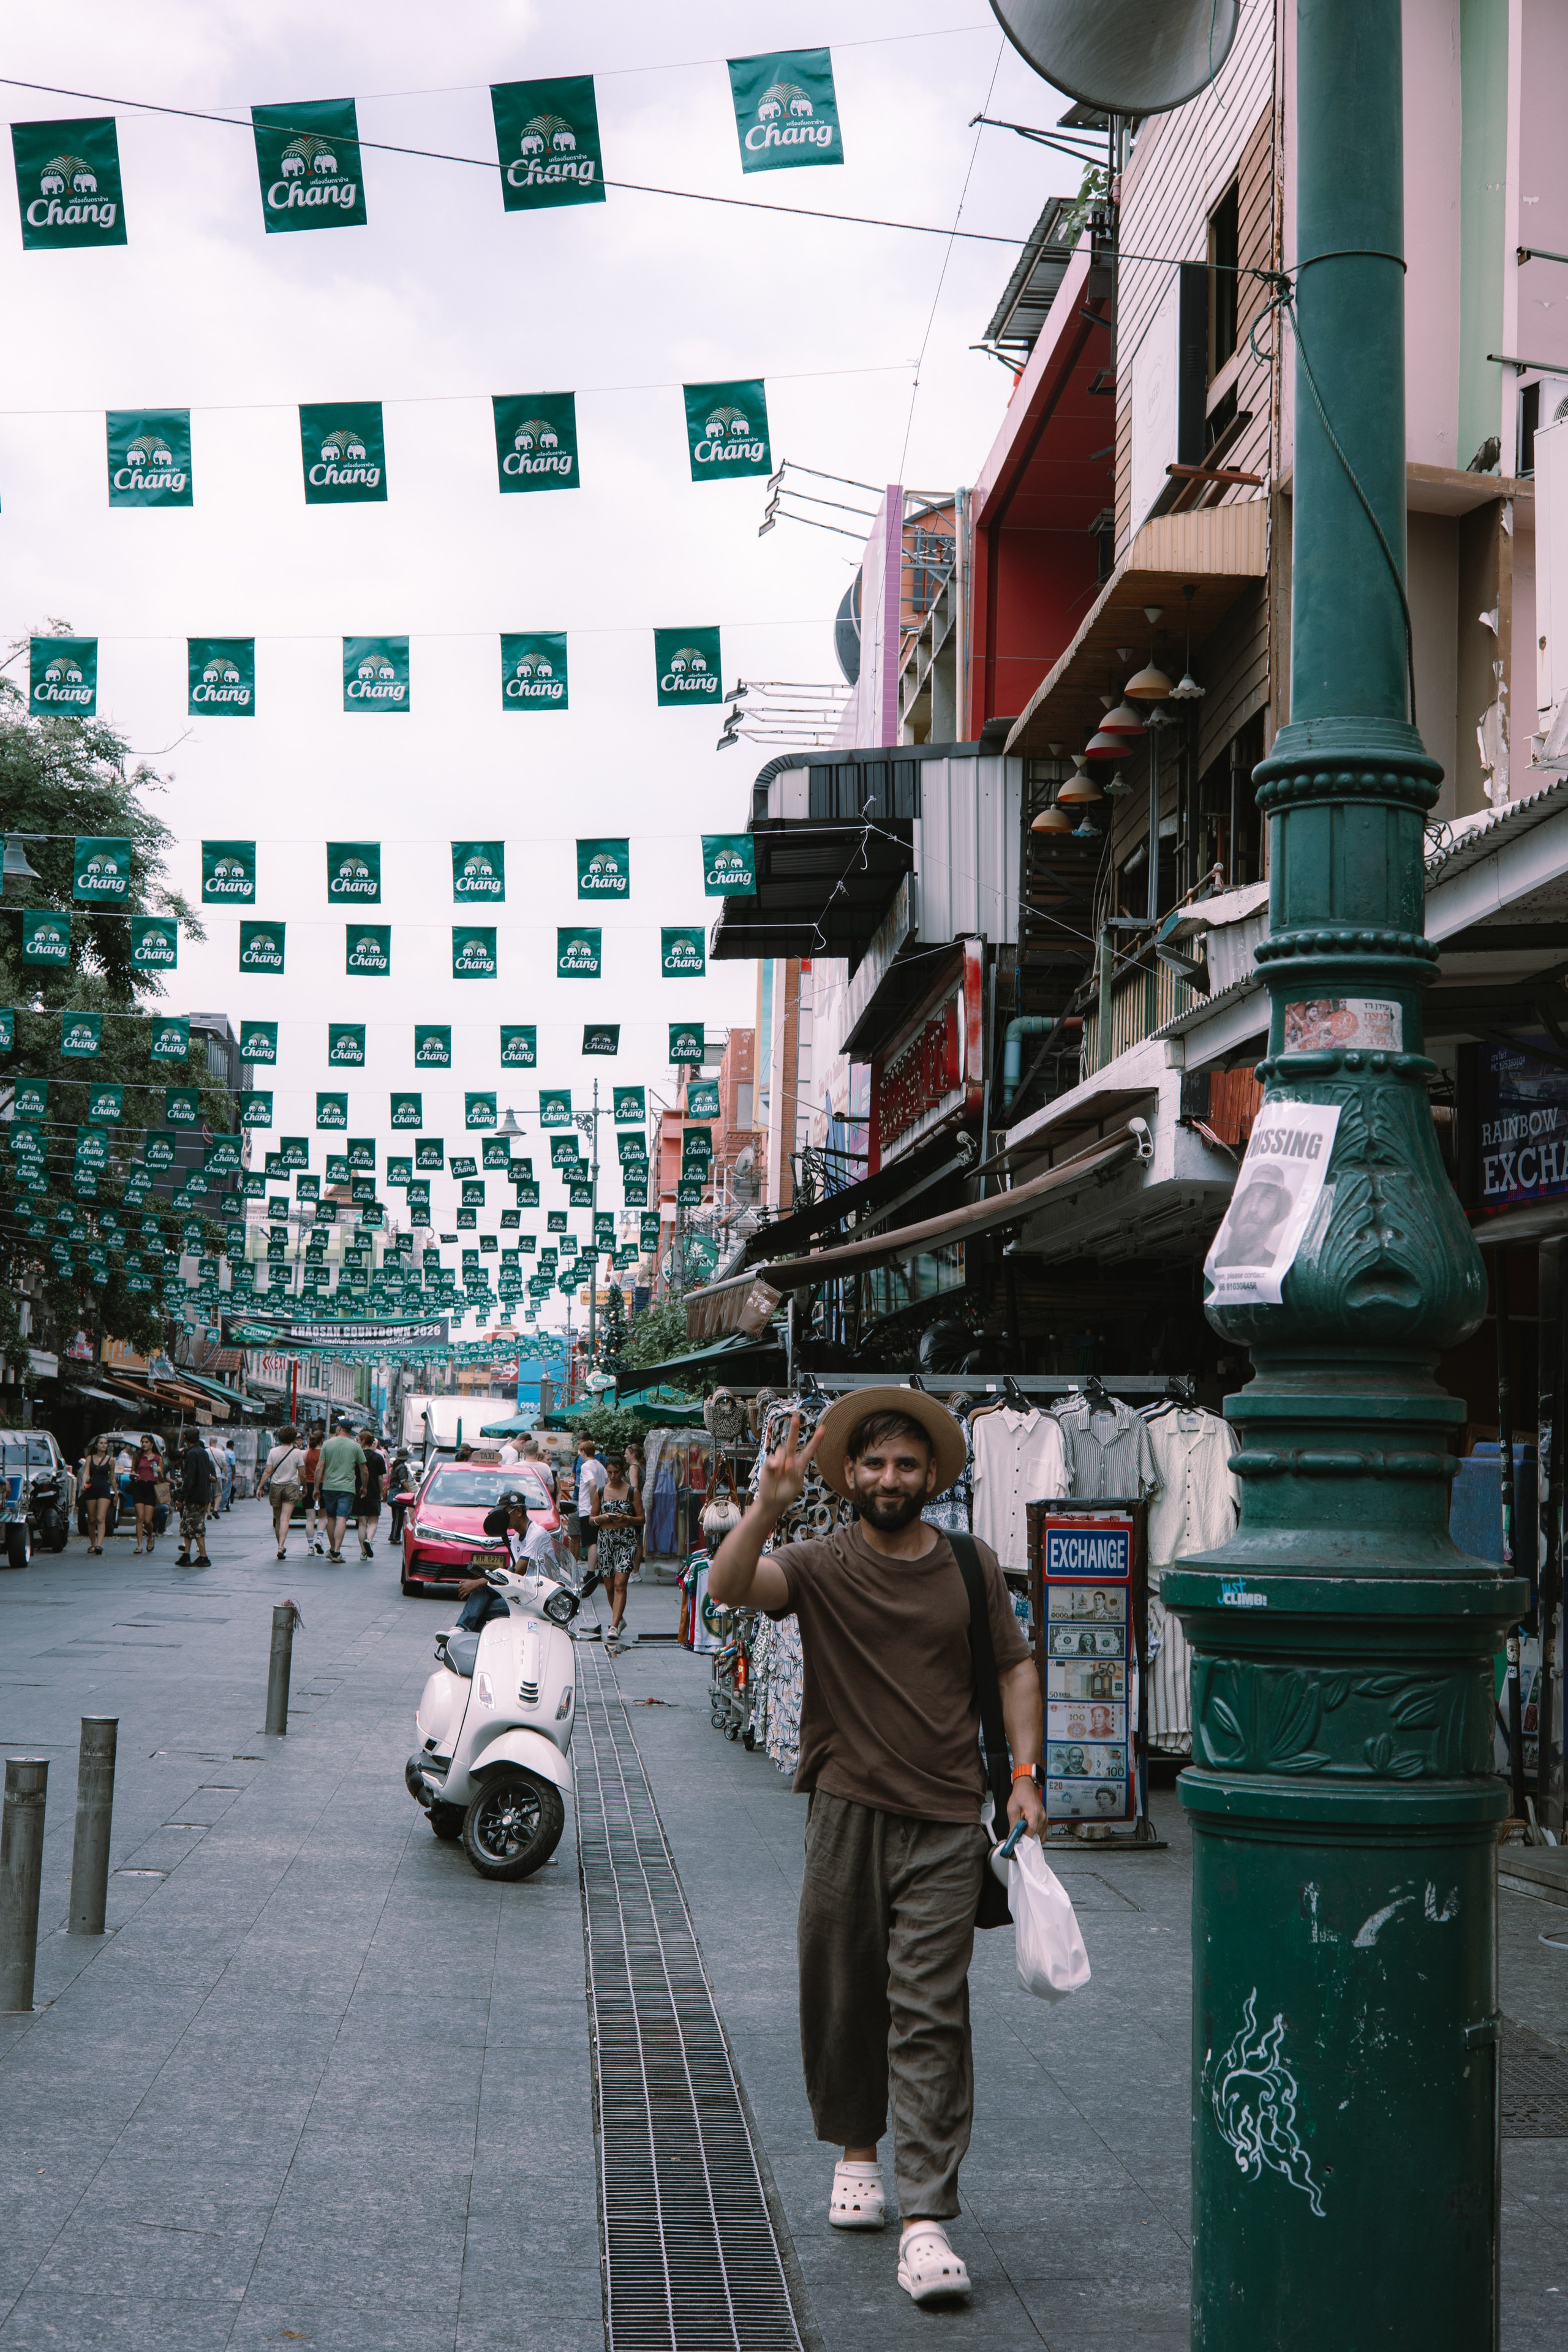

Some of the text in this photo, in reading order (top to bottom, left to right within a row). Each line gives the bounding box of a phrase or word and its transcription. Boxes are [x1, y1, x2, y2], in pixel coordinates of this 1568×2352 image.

[745, 122, 834, 151] Chang
[507, 158, 596, 187] Chang
[309, 176, 349, 185] เครื่องดื่มตราช้าง
[69, 195, 108, 205] เครื่องดื่มตราช้าง
[268, 181, 356, 209] Chang
[28, 198, 116, 228] Chang
[695, 441, 764, 463] Chang
[503, 453, 572, 475] Chang
[115, 469, 186, 492] Chang
[310, 464, 380, 487] Chang
[662, 674, 718, 692] Chang
[34, 684, 93, 704] Chang
[193, 684, 250, 705] Chang
[347, 680, 405, 701] Chang
[506, 680, 564, 699] Chang
[78, 875, 126, 892] Chang
[581, 875, 626, 891] Chang
[707, 871, 752, 886] Chang
[205, 878, 253, 895] Chang
[331, 879, 377, 895] Chang
[456, 878, 501, 893] Chang
[26, 942, 67, 957] Chang
[135, 948, 175, 962] Chang
[243, 951, 282, 966] Chang
[349, 954, 387, 968] Chang
[560, 957, 598, 971] Chang
[665, 957, 703, 970] Chang
[456, 958, 494, 971] Chang
[64, 1038, 97, 1051] Chang
[154, 1042, 186, 1055] Chang
[585, 1041, 616, 1052] Chang
[241, 1047, 274, 1059] Chang
[331, 1049, 363, 1061] Chang
[417, 1051, 450, 1063] Chang
[502, 1051, 533, 1063] Chang
[671, 1047, 702, 1058] Chang
[1491, 1063, 1499, 1072] MC
[16, 1101, 44, 1112] Chang
[92, 1106, 120, 1117] Chang
[690, 1103, 718, 1113] Chang
[167, 1109, 195, 1121] Chang
[244, 1112, 271, 1123] Chang
[541, 1112, 570, 1122] Chang
[616, 1109, 644, 1118] Chang
[317, 1115, 345, 1125] Chang
[393, 1115, 421, 1125] Chang
[467, 1115, 496, 1125] Chang
[1482, 1107, 1558, 1147] RAINBOW
[11, 1141, 37, 1151] Chang
[78, 1146, 104, 1156] Chang
[685, 1145, 711, 1155] Chang
[148, 1150, 173, 1159] Chang
[214, 1154, 239, 1163] Chang
[620, 1152, 645, 1160] Chang
[282, 1156, 307, 1166] Chang
[349, 1156, 374, 1166] Chang
[417, 1157, 442, 1166] Chang
[484, 1156, 509, 1165] Chang
[17, 1168, 38, 1178] Chang
[205, 1165, 227, 1175] Chang
[266, 1168, 288, 1177] Chang
[453, 1166, 475, 1175] Chang
[509, 1171, 531, 1180] Chang
[326, 1171, 349, 1181] Chang
[388, 1174, 410, 1183] Chang
[564, 1172, 586, 1182] Chang
[624, 1174, 647, 1183] Chang
[684, 1171, 706, 1182] Chang
[186, 1183, 208, 1192] Chang
[407, 1194, 429, 1203] Chang
[1227, 1272, 1243, 1281] please
[243, 1325, 440, 1338] Chang KHAOSAN COUNTDOWN 2026
[1050, 1538, 1125, 1569] EXCHANGE
[1218, 1577, 1246, 1604] just
[1224, 1593, 1267, 1606] CLIMB!
[1099, 1662, 1116, 1676] 50
[1106, 1767, 1125, 1777] 100
[1049, 1781, 1063, 1790] £20
